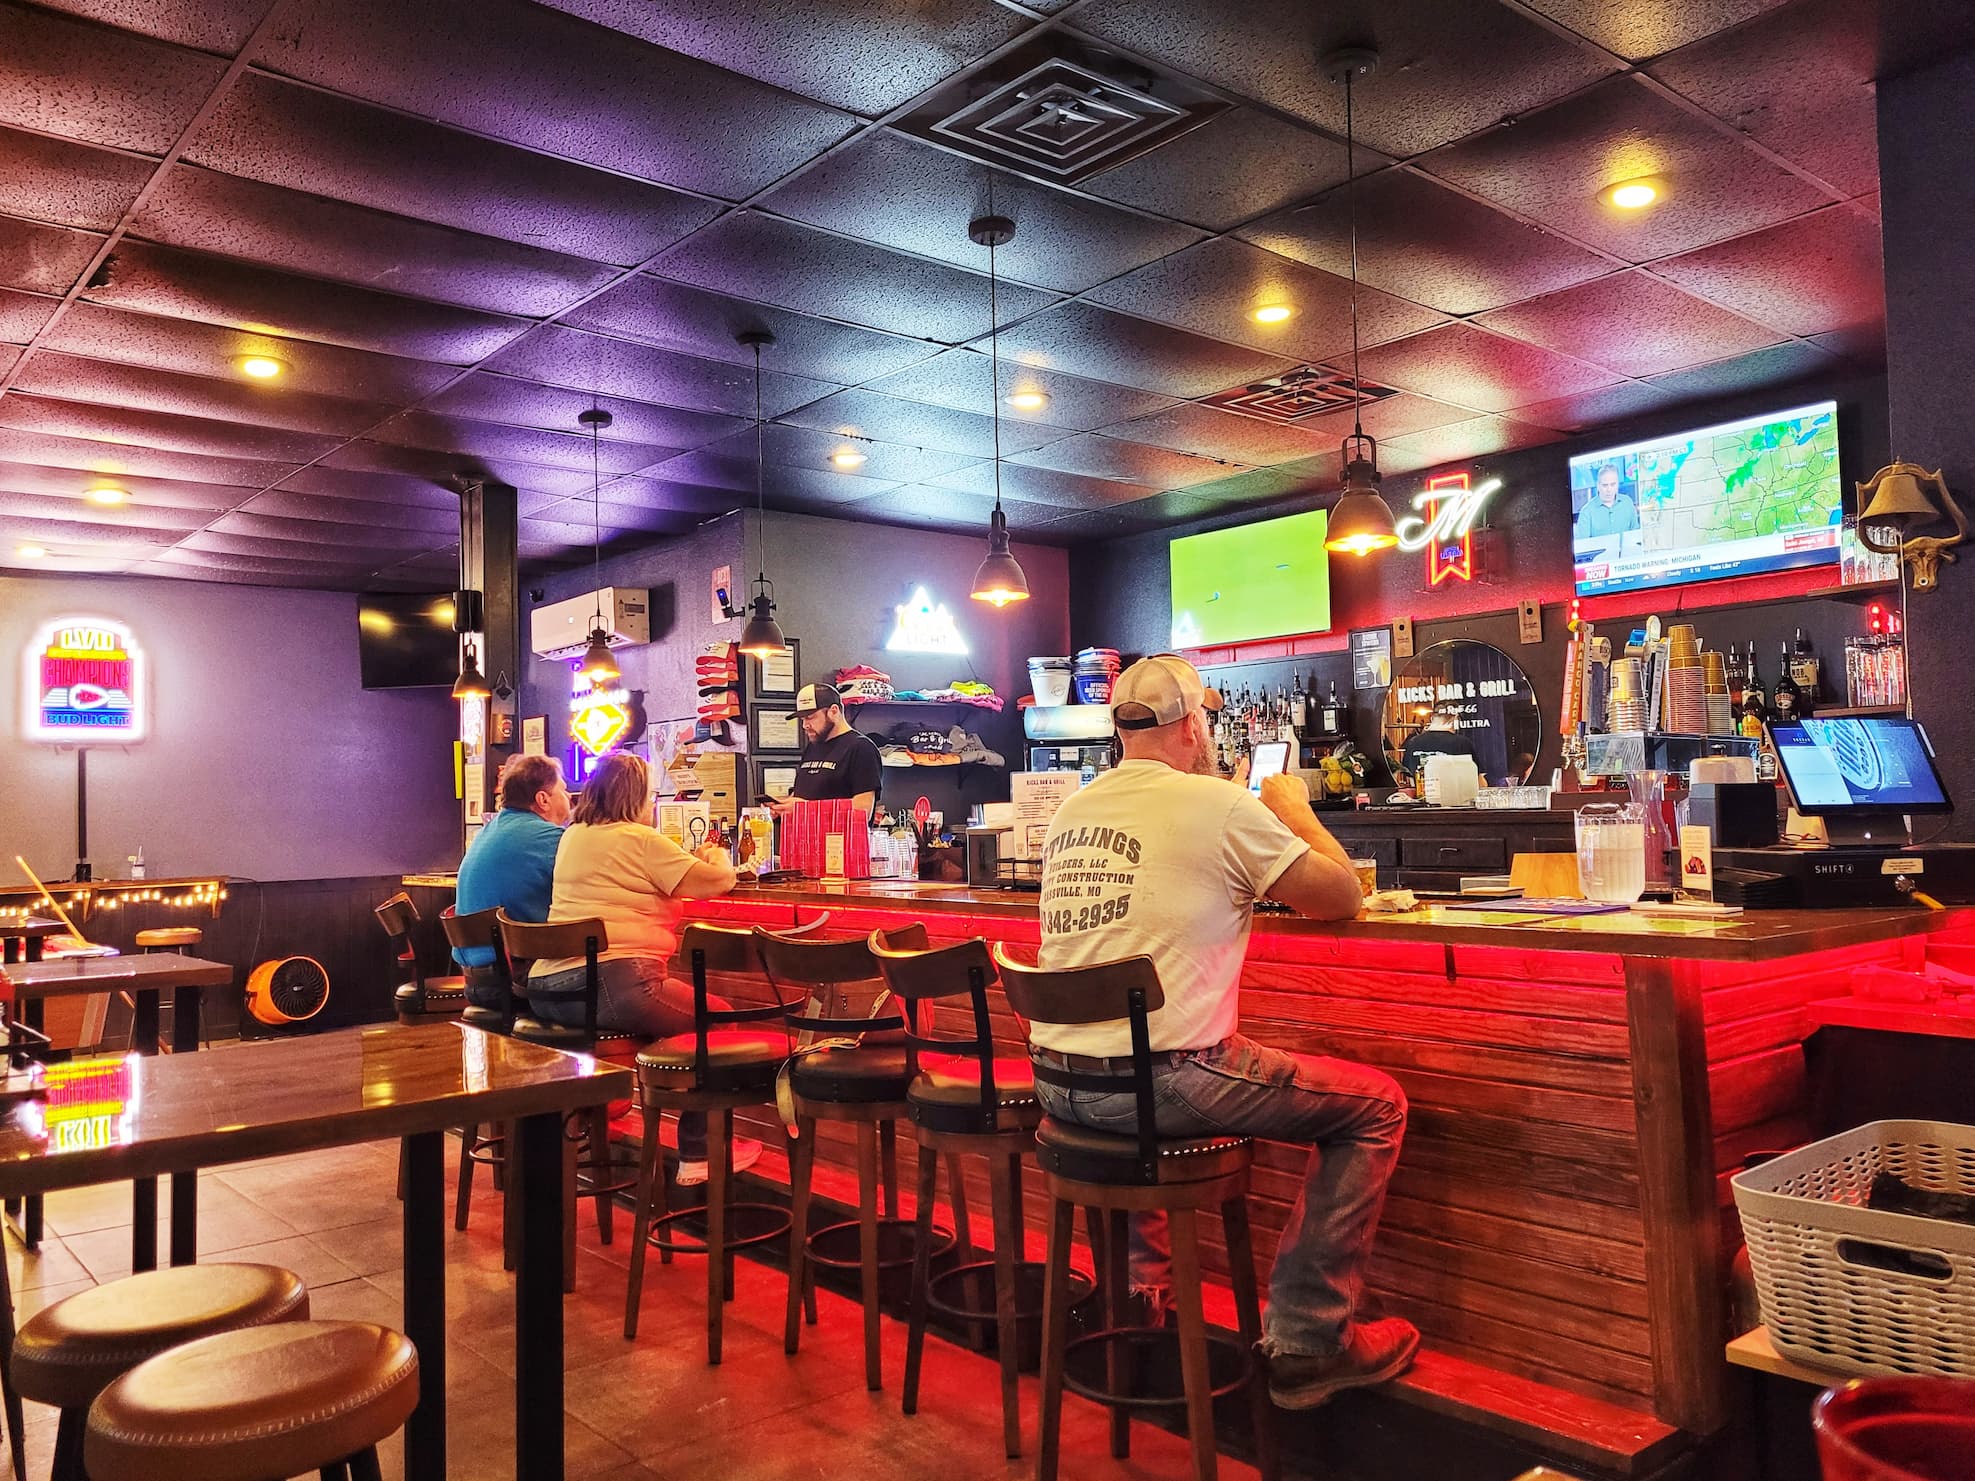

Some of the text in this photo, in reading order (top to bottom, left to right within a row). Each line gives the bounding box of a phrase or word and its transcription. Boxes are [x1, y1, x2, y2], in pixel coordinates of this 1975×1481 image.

[1671, 553, 1701, 564] MICHIGAN
[1586, 569, 1608, 580] NOW
[1398, 679, 1517, 704] KICKS BAR & GRILL
[46, 713, 129, 726] BUD LIGHT
[1460, 719, 1491, 729] ULTRA
[1089, 858, 1109, 868] LLC
[1056, 872, 1135, 885] CONSTRUCTION
[1087, 886, 1101, 897] MO
